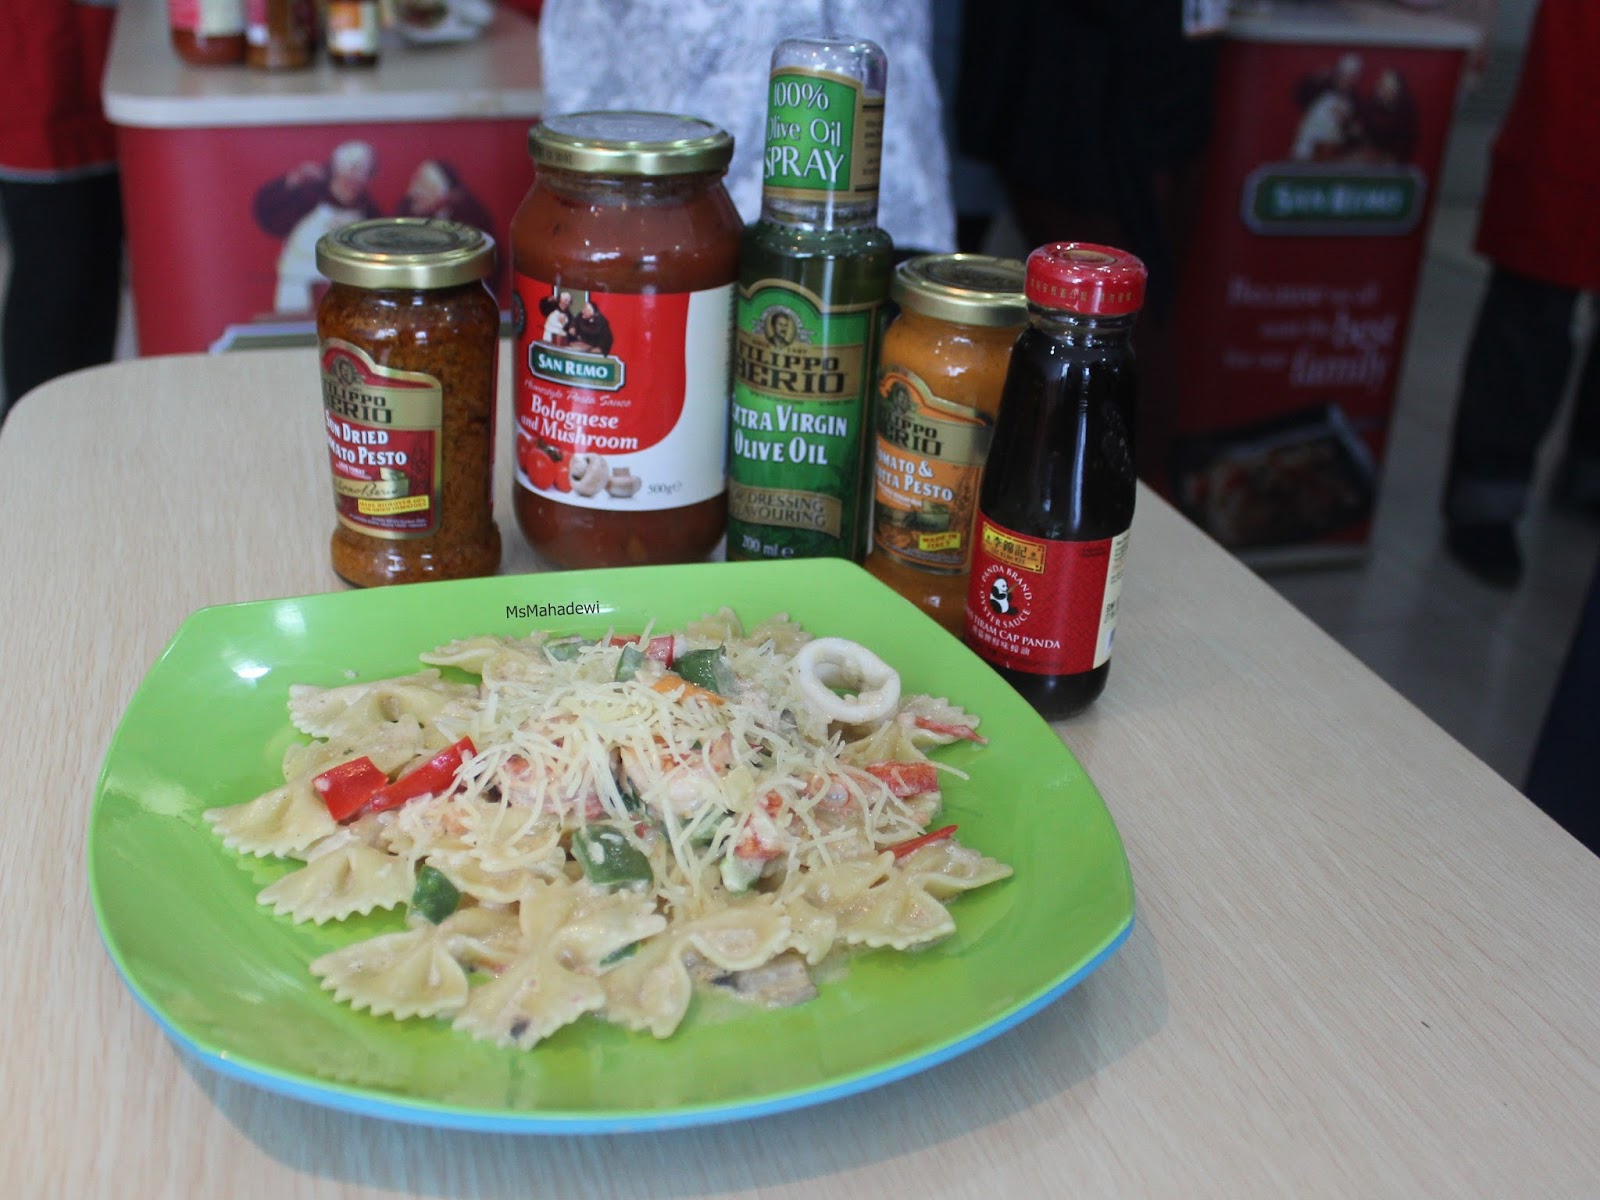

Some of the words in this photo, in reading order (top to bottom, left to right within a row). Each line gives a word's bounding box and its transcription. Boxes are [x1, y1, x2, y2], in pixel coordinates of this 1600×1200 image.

[773, 81, 830, 111] 100%
[809, 117, 841, 147] Oil
[765, 145, 844, 183] SPRAY
[538, 353, 563, 372] SAN
[564, 360, 608, 379] REMO
[531, 393, 619, 430] Bolognese
[732, 402, 773, 431] XTRA
[776, 404, 848, 438] VIRGIN
[341, 422, 389, 445] DRIED
[520, 414, 539, 432] and
[540, 417, 639, 450] Mushroom
[734, 428, 785, 463] OLIVE
[788, 436, 828, 465] OIL
[357, 445, 408, 466] PESTO
[918, 460, 934, 478] &
[904, 474, 954, 502] PESTO
[981, 564, 1005, 584] PANDA
[1006, 568, 1033, 601] BRAND
[1002, 608, 1032, 629] SAUCE
[999, 629, 1020, 644] CAP
[1022, 636, 1062, 649] PANDA
